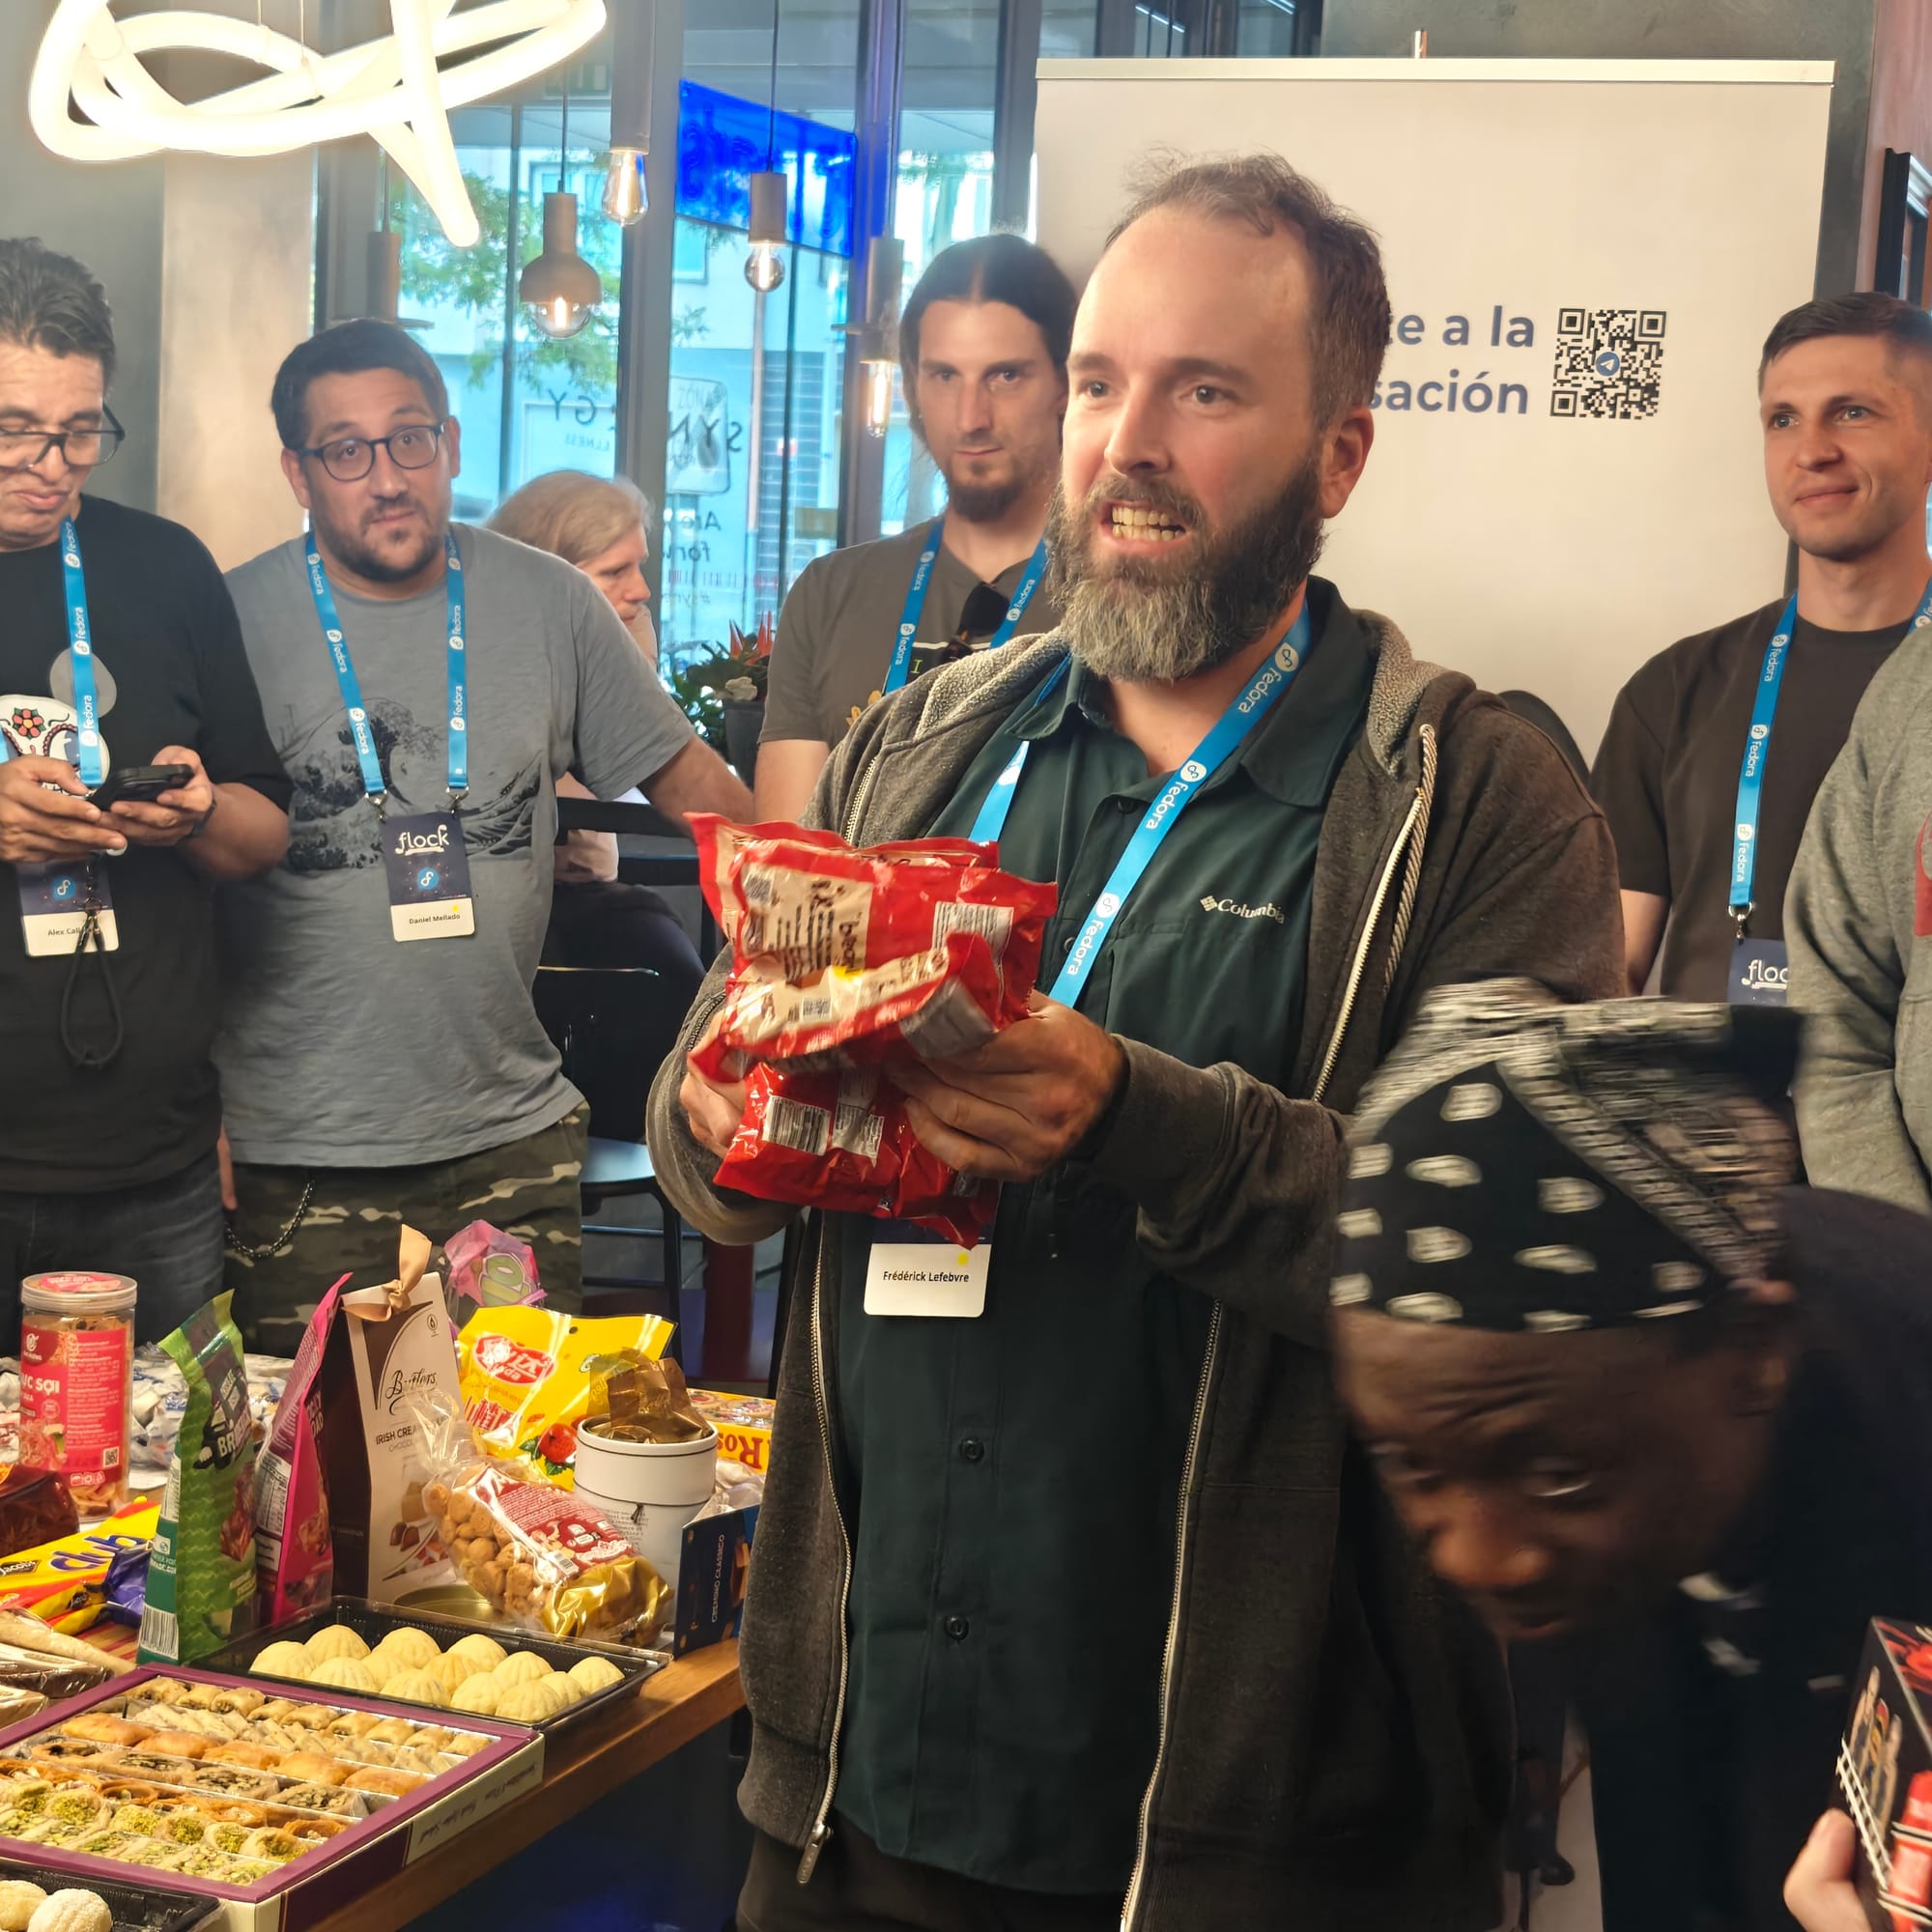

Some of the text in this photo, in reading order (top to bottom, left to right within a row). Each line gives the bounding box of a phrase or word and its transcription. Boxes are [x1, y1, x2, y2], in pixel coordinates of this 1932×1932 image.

[1391, 305, 1534, 348] e a la
[311, 565, 324, 595] fedora
[1014, 579, 1036, 608] fedora
[75, 607, 85, 639] fedora
[452, 605, 461, 635] fedora
[332, 643, 347, 673] fedora
[895, 637, 910, 666] fedora
[1765, 647, 1783, 683] fedora
[452, 685, 463, 717] fedora
[1238, 667, 1282, 714] fedora
[82, 695, 93, 730] fedora
[355, 723, 370, 755] fedora
[1746, 739, 1759, 778] fedora
[1146, 780, 1188, 831] fedora
[395, 824, 449, 854] flock
[1736, 841, 1748, 883] fedora
[409, 916, 432, 924] Daniel
[1217, 898, 1285, 924] Columbia
[1067, 920, 1102, 976] fedora
[1742, 959, 1788, 988] floc
[883, 1270, 970, 1283] Frédérick Lefebvre
[376, 1424, 417, 1445] IRISH CREA
